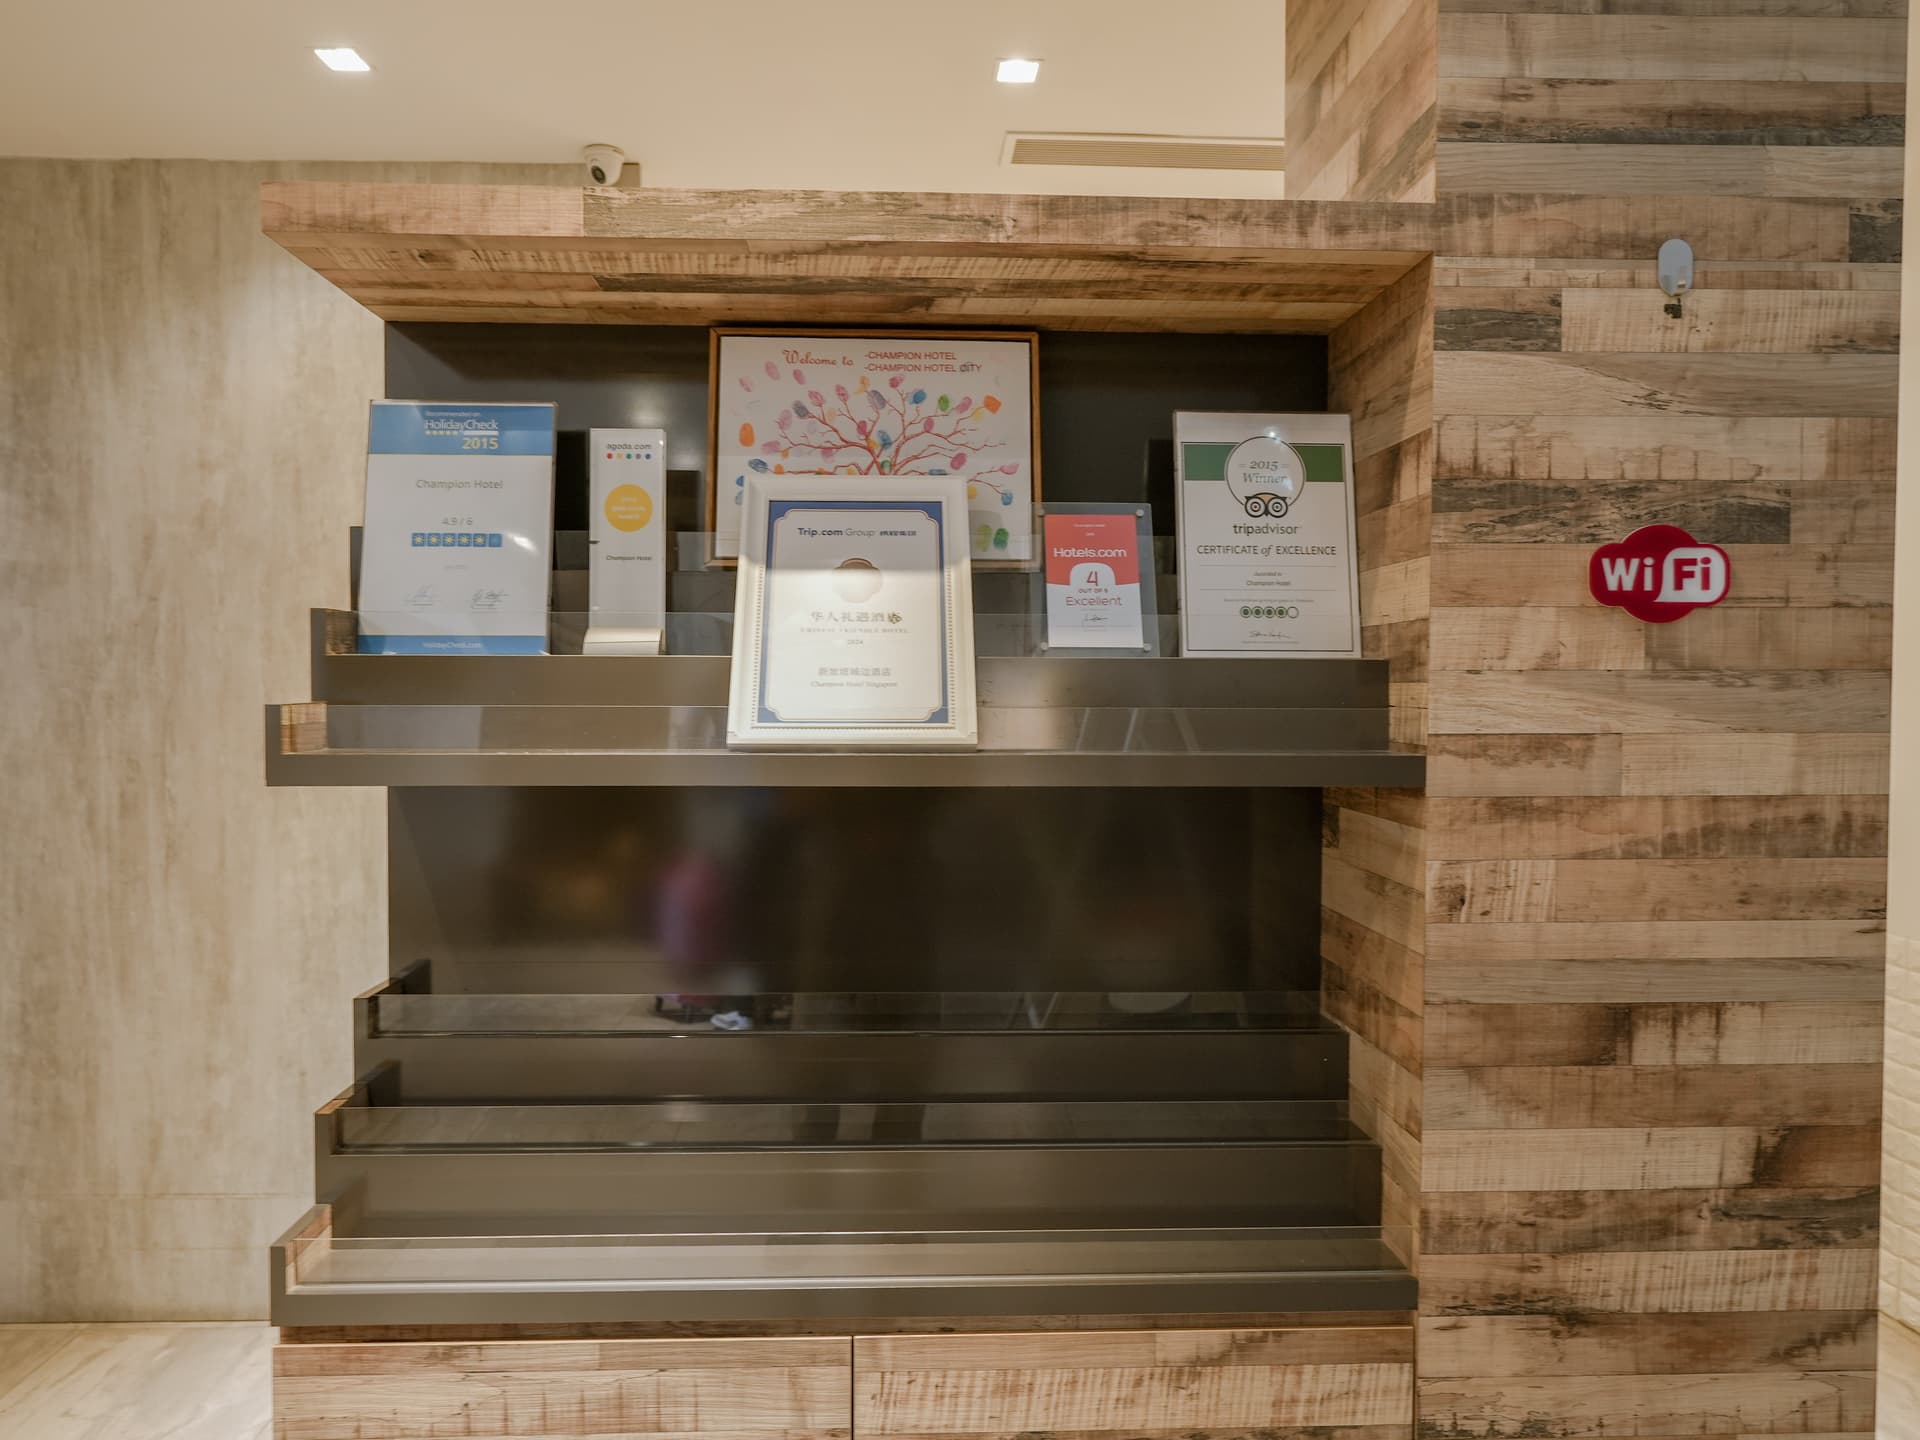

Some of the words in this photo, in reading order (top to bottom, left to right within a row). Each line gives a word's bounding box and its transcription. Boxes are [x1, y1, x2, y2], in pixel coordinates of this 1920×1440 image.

[782, 350, 837, 366] Welcome
[842, 356, 854, 366] to
[924, 352, 957, 361] HOTEL
[923, 364, 957, 373] HOTEL
[424, 419, 499, 432] HolidayCheck
[462, 437, 499, 450] 2015
[1249, 460, 1279, 472] 2015
[1243, 472, 1288, 484] Winner
[415, 479, 471, 490] Champion
[473, 480, 504, 489] Hotel
[797, 527, 843, 538] Trip.com
[845, 528, 876, 538] Group
[1232, 523, 1300, 537] tripadvisor
[1053, 547, 1127, 558] Hotels.com
[1196, 544, 1259, 555] CERTIFICATE
[1260, 544, 1274, 557] of
[1275, 545, 1337, 556] EXCELLENCE
[1086, 570, 1099, 587] 4
[1065, 596, 1123, 606] Excellent
